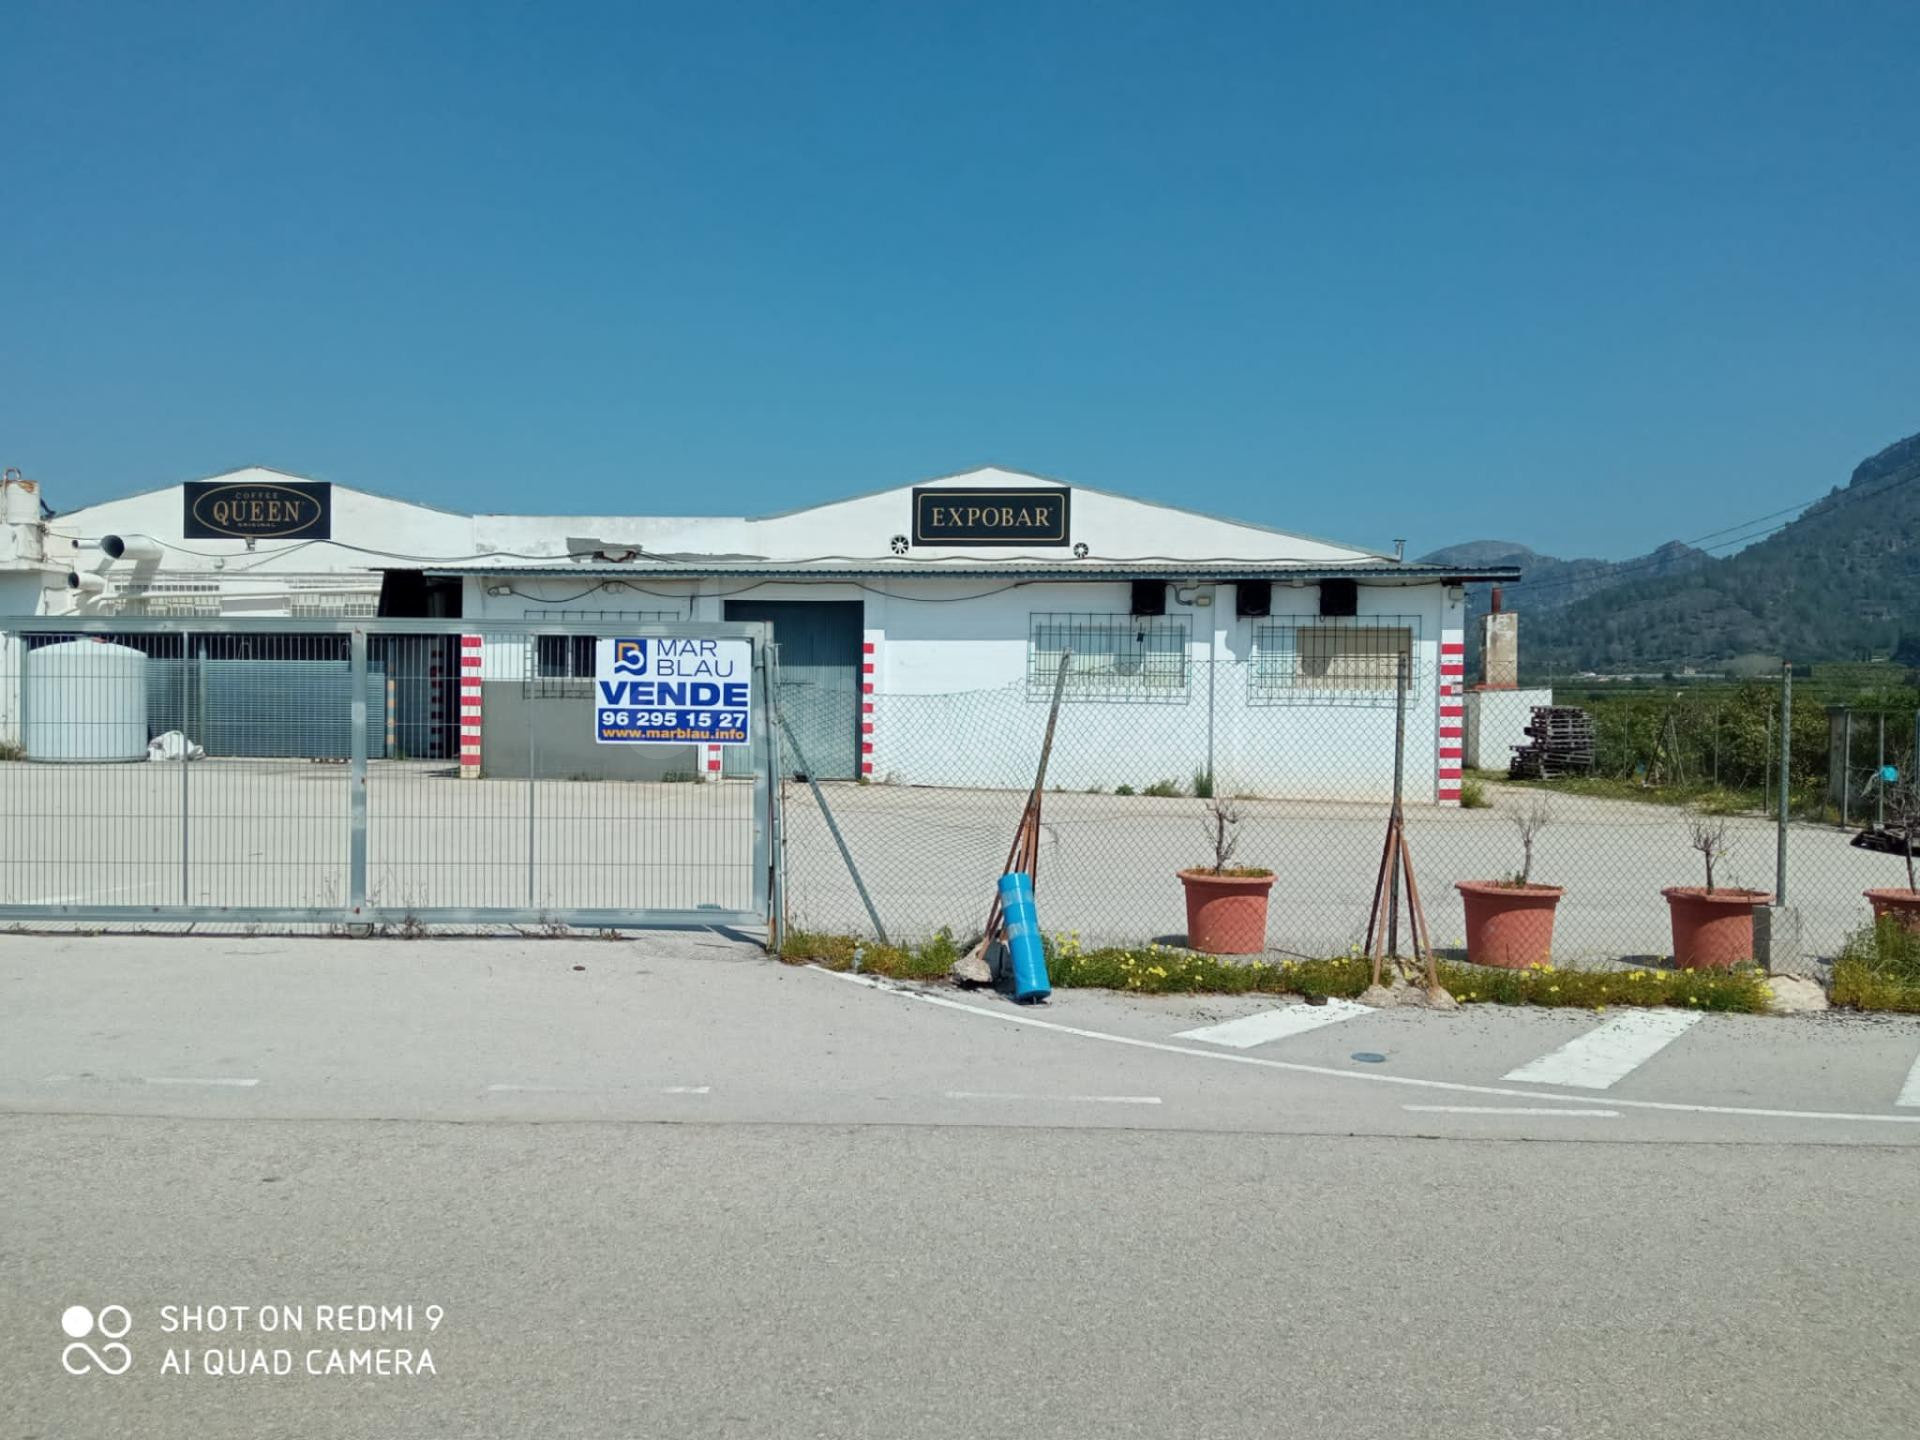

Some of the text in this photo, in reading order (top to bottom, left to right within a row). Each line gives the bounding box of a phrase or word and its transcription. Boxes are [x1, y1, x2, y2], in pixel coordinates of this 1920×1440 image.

[234, 491, 278, 500] COFFEE
[212, 500, 301, 526] QUEEN
[932, 507, 1051, 527] EXPOBAR
[657, 639, 717, 657] MAR
[657, 659, 734, 678] BLAU
[599, 681, 749, 707] VENDE
[602, 711, 745, 728] 96 295 15 27
[603, 727, 746, 740] www.marblau.info
